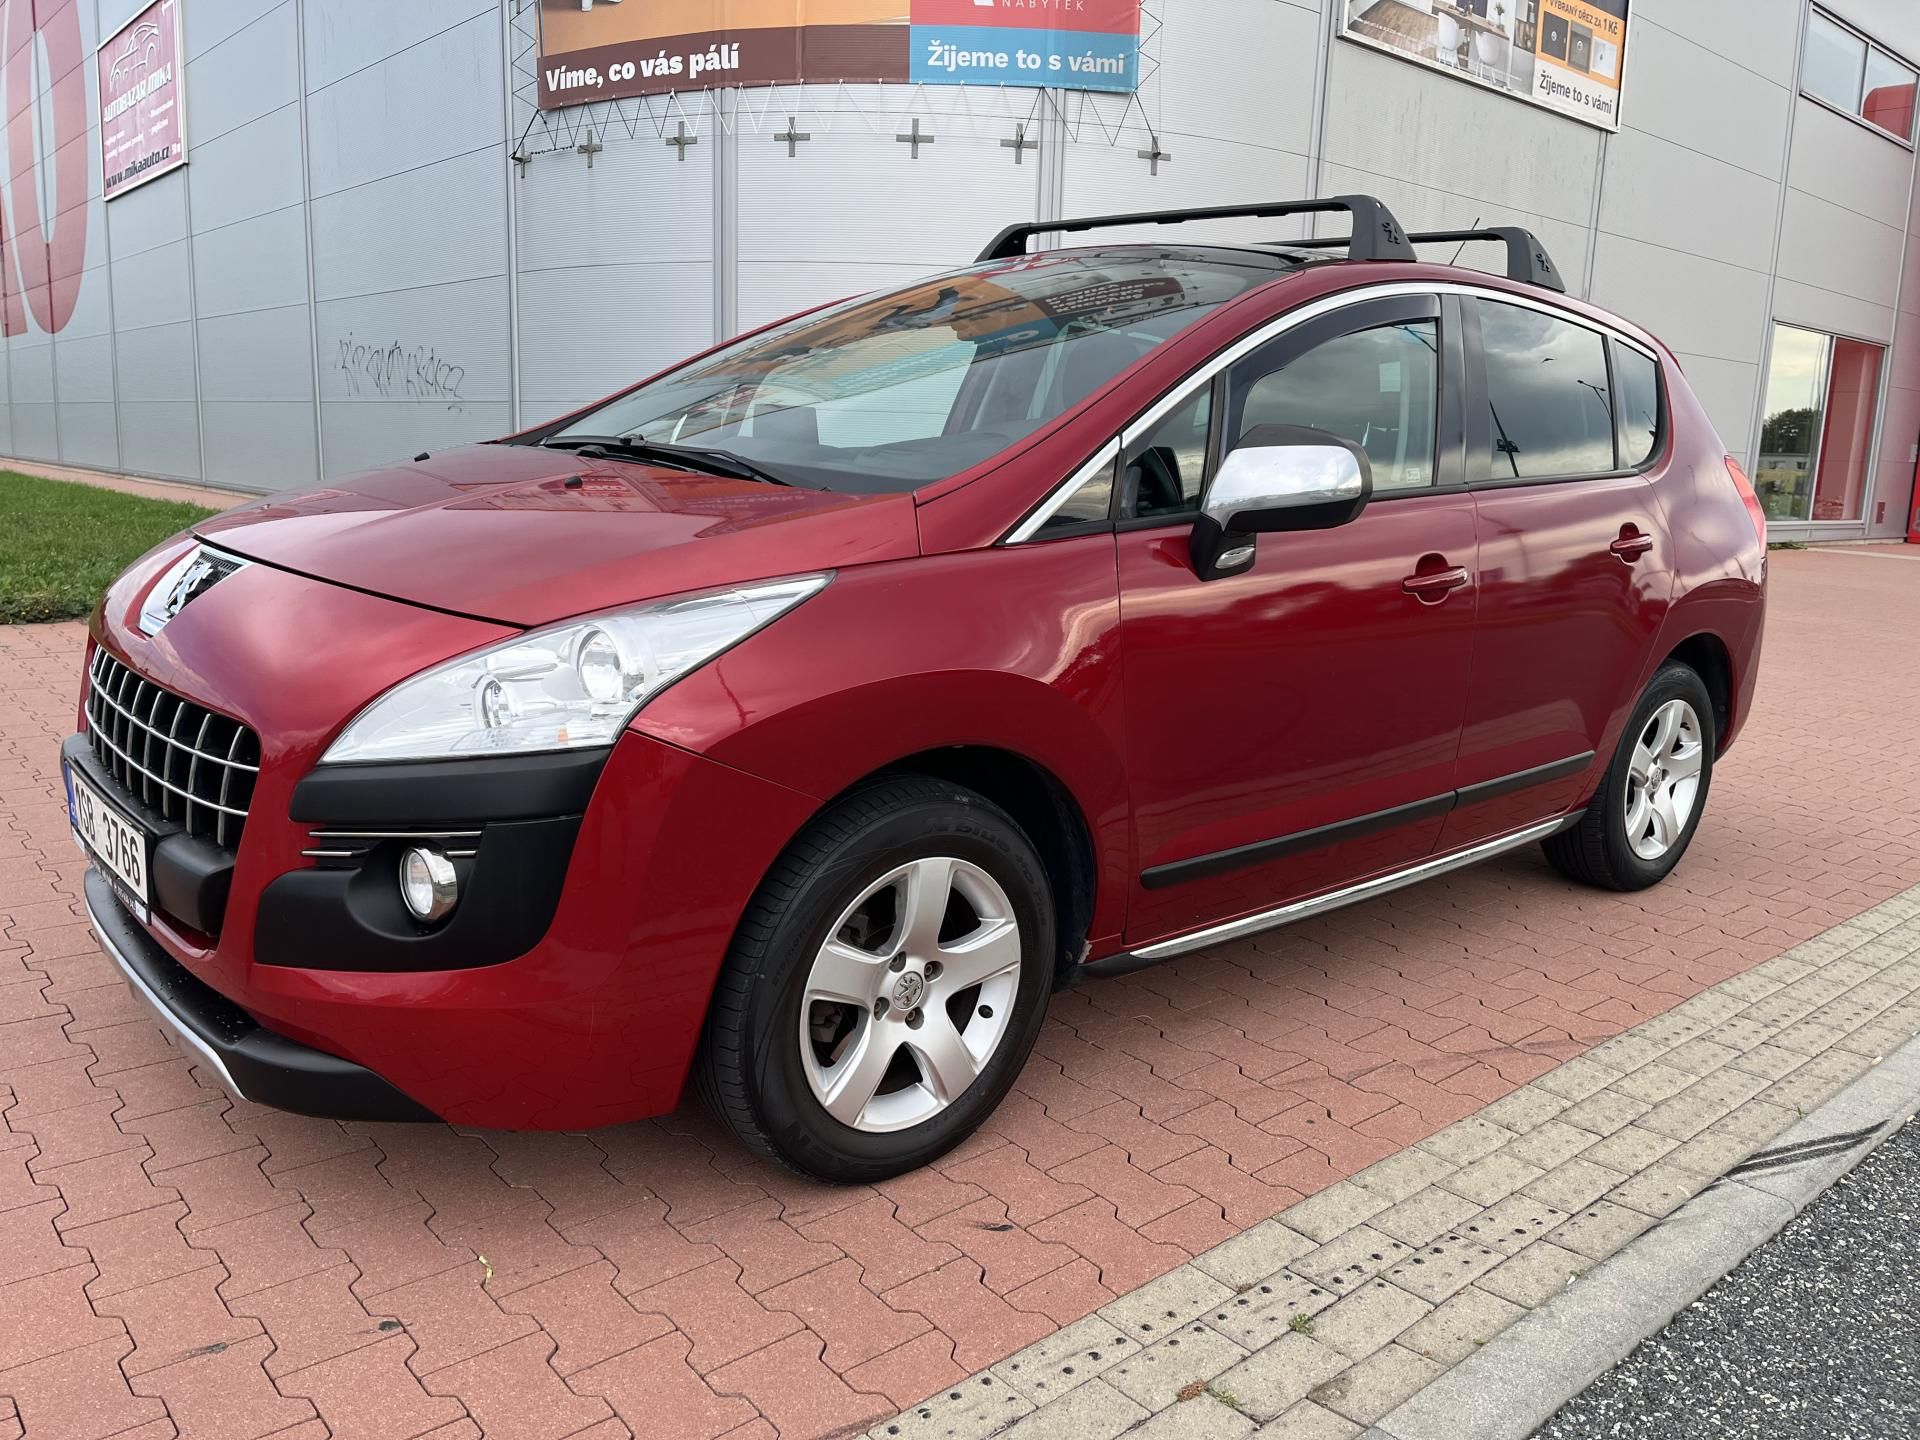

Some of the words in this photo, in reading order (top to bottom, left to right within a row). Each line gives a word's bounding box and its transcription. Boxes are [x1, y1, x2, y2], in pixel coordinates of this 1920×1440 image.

[546, 65, 604, 92] Víme,
[608, 62, 635, 82] co
[640, 50, 683, 77] vás
[689, 43, 740, 79] pálí
[927, 40, 1009, 72] Žijeme
[1016, 50, 1041, 70] to
[1048, 54, 1062, 71] s
[1068, 51, 1124, 75] vámi
[103, 79, 147, 124] AUTOBAZAR
[147, 61, 172, 95] MIKA
[1539, 70, 1571, 100] Žijeme
[1573, 84, 1583, 103] to
[1584, 92, 1590, 106] s
[1591, 92, 1613, 115] vámi
[105, 146, 169, 189] www.mikaauto.cz
[102, 811, 141, 888] 3766
